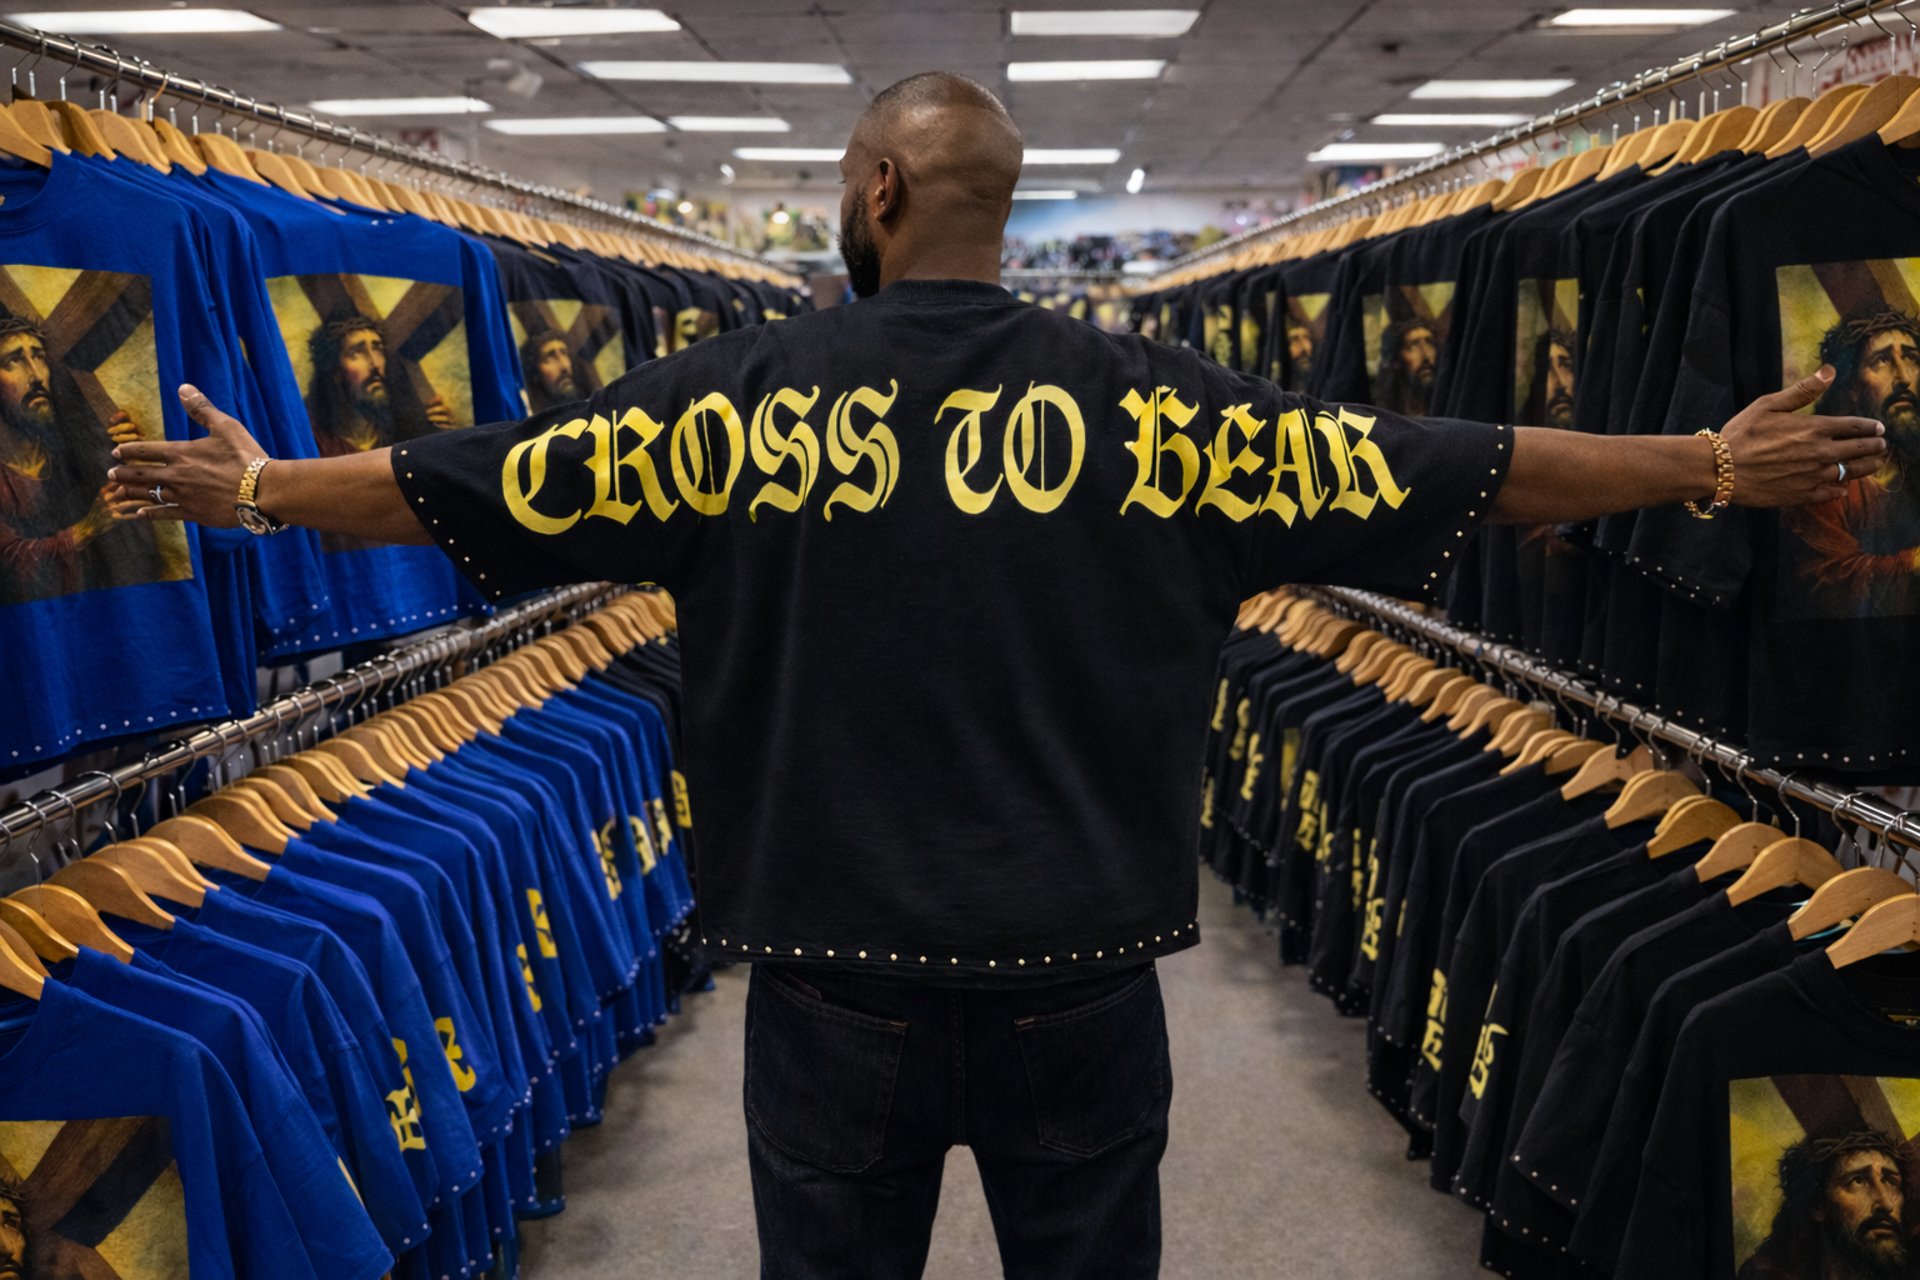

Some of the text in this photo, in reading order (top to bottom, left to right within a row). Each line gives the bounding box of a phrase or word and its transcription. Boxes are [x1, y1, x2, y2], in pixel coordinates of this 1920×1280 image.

[501, 378, 1412, 535] CROSS TO BEAR
